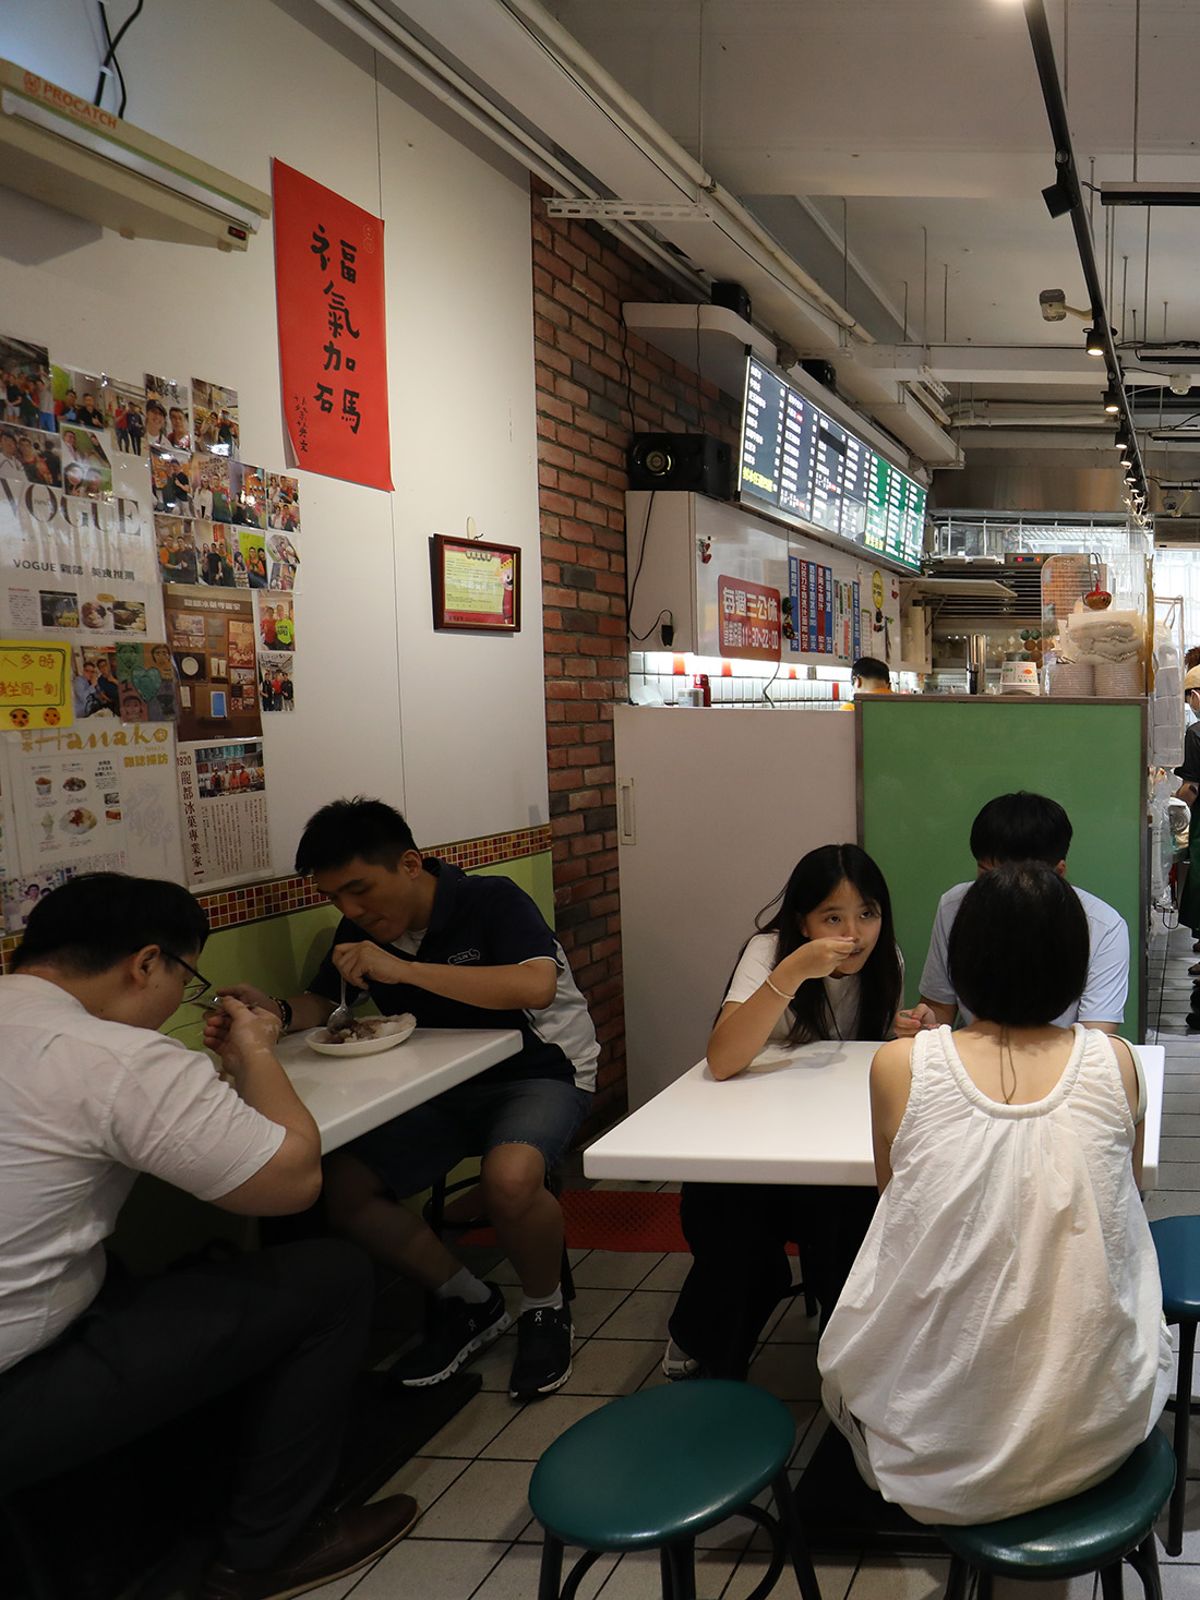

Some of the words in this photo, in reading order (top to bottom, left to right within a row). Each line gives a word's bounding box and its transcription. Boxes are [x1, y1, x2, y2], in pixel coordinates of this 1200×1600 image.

[44, 80, 118, 129] PROCATCH
[310, 224, 361, 434] 福氣加碼
[12, 559, 57, 573] VOGUE
[722, 586, 778, 622] 每週三公休
